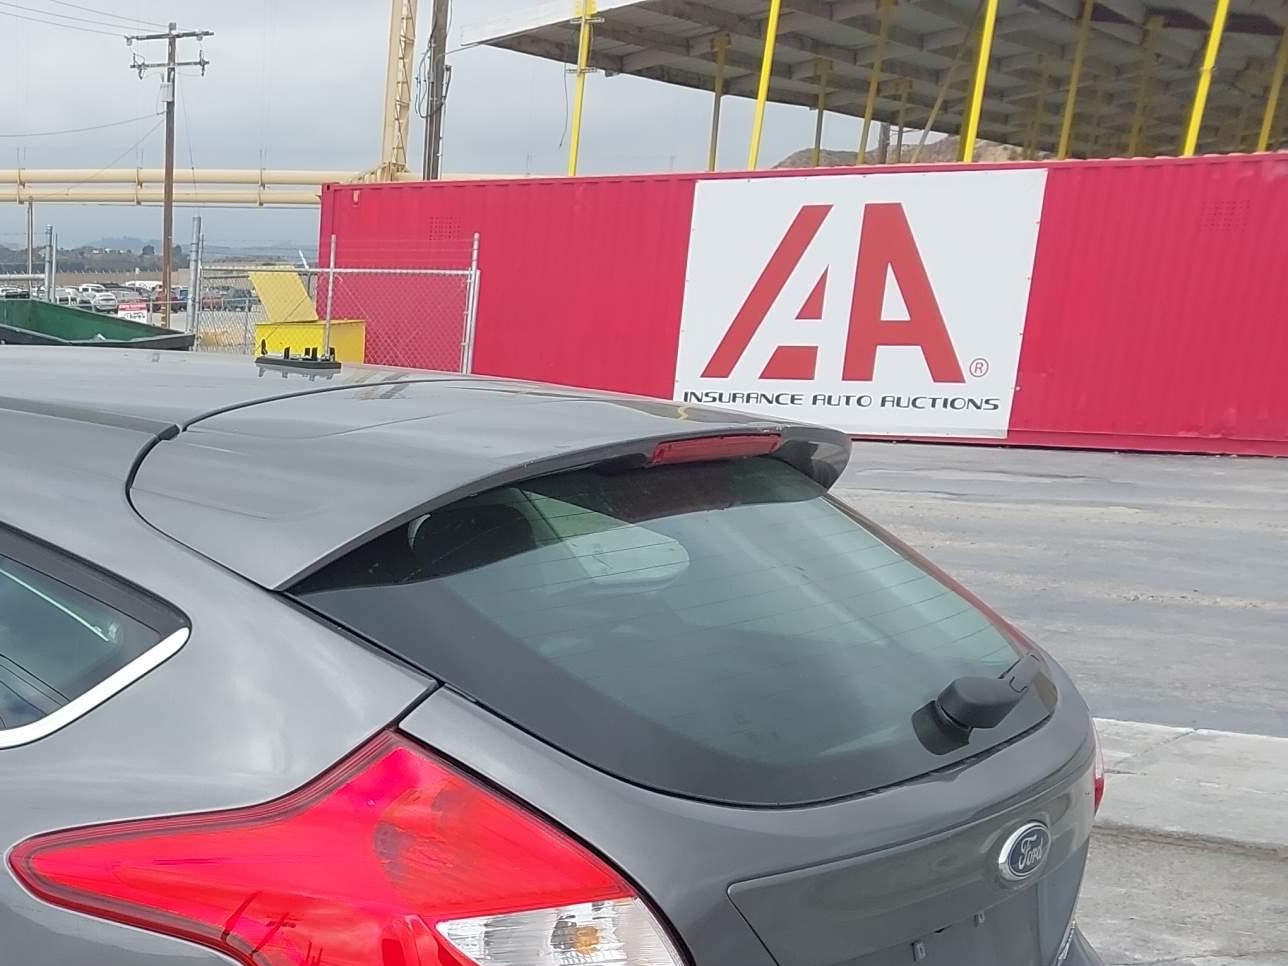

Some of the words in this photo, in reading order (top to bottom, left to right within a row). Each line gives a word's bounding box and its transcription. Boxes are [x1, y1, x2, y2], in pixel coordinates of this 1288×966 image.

[683, 391, 804, 406] INSURANCE
[812, 394, 873, 408] AUTO
[880, 395, 1000, 411] AUCTIONS
[1018, 834, 1042, 870] Ford
